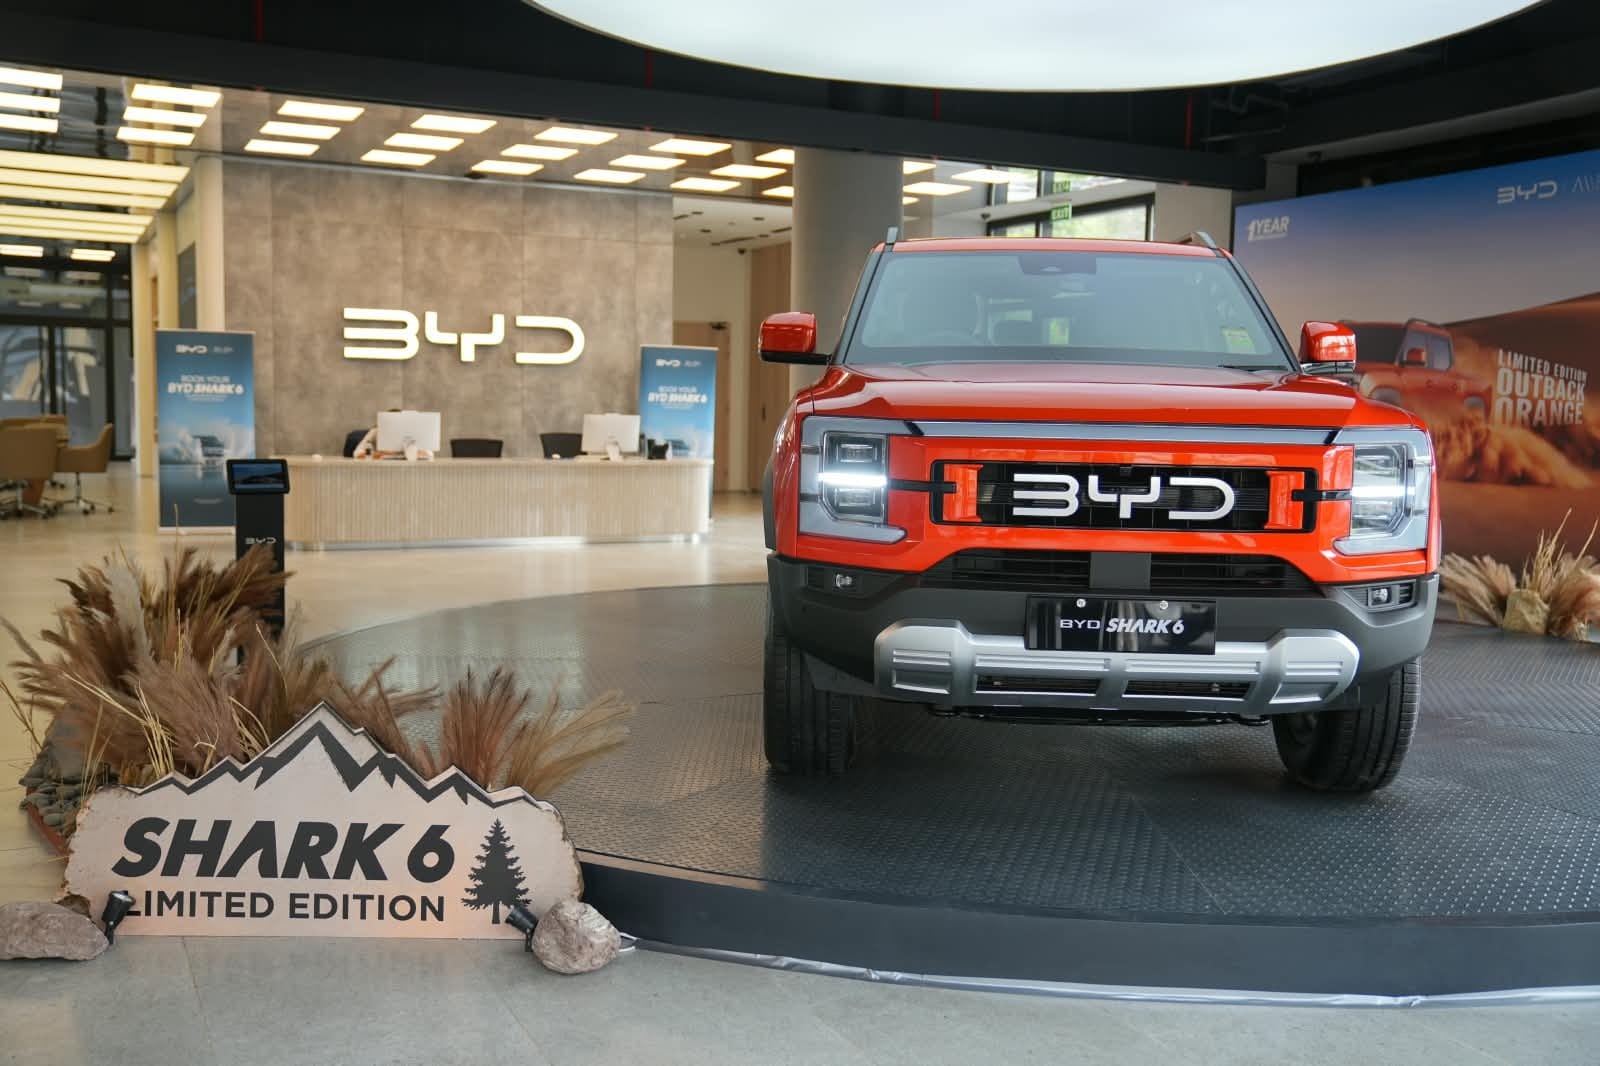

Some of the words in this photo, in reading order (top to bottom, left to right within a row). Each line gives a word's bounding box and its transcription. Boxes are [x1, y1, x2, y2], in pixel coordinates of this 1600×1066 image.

[1497, 180, 1558, 204] BYD
[175, 344, 208, 354] BYD
[343, 307, 586, 365] BYD
[655, 358, 681, 367] BYD
[1497, 348, 1551, 375] LIMITED
[1553, 362, 1588, 384] EDITION
[168, 383, 192, 393] BYD
[194, 384, 235, 394] SHARK
[648, 392, 667, 402] BYD
[1496, 367, 1586, 402] OUTBACK
[1494, 396, 1585, 427] ORANGE
[1012, 473, 1236, 520] BYD
[245, 536, 277, 545] BYD
[1060, 619, 1101, 630] BYD
[1105, 617, 1172, 634] SHARK
[1172, 619, 1185, 635] 6
[111, 816, 405, 882] SHARK
[406, 824, 456, 883] 6
[288, 892, 445, 922] EDITION
